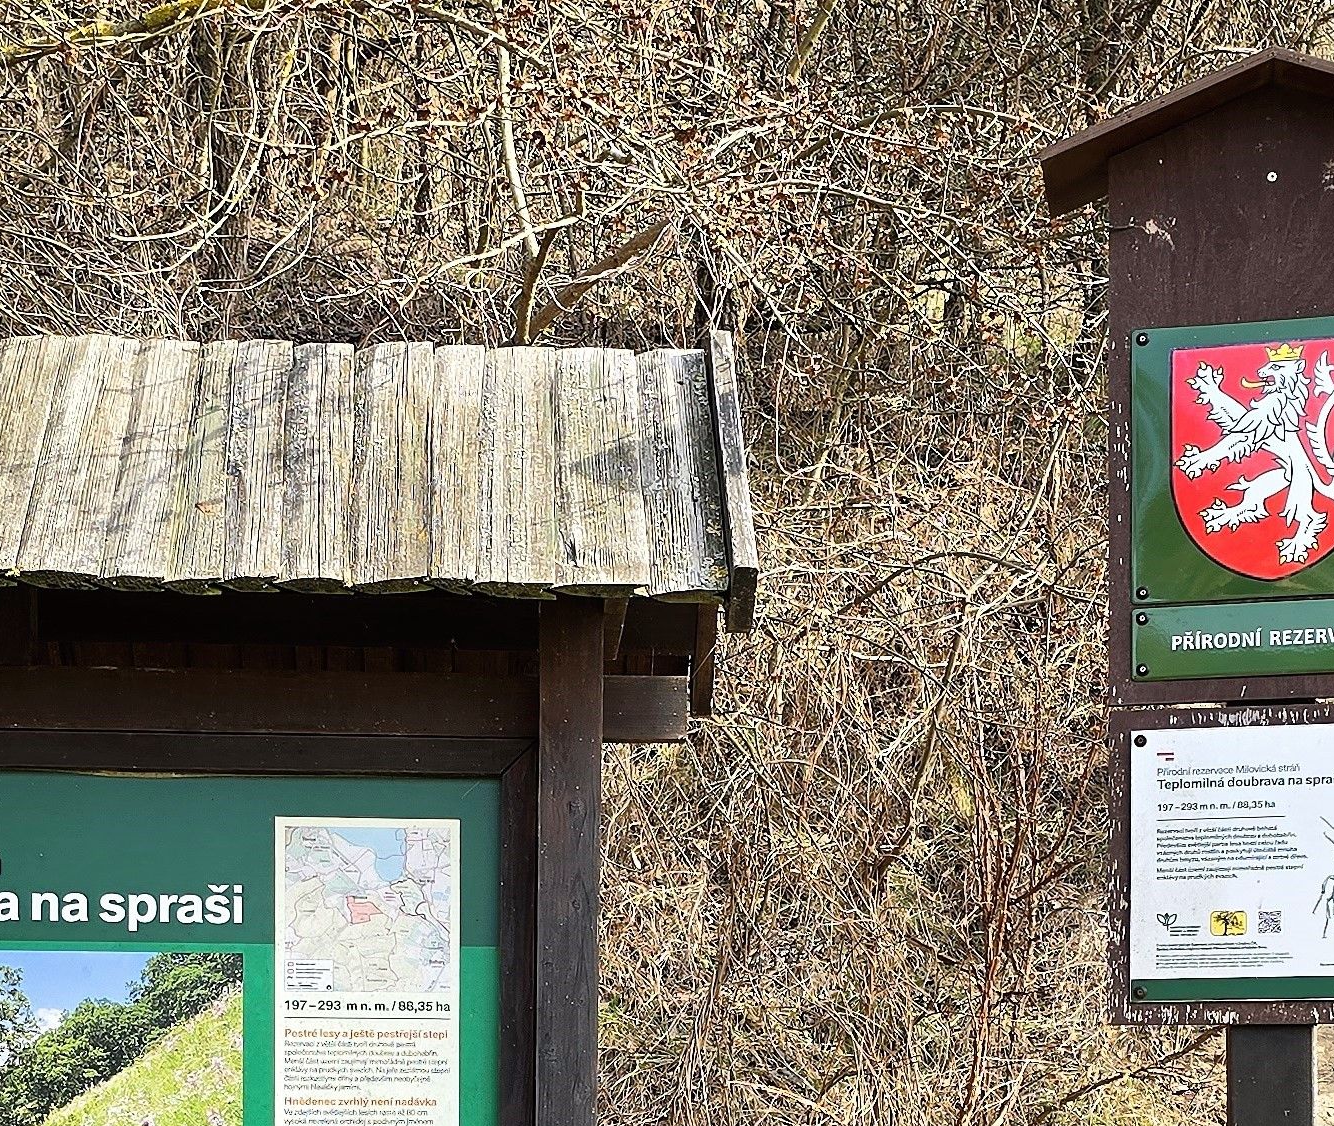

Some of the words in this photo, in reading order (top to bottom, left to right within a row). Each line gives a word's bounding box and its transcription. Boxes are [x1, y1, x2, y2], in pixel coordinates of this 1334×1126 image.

[1171, 627, 1262, 651] PŘÍRODNÍ
[1157, 767, 1191, 777] Přírodní
[1192, 767, 1233, 775] rezervace
[1236, 765, 1276, 774] Milovická
[1279, 763, 1300, 773] stráň
[1157, 776, 1224, 791] Teplomilná
[1227, 775, 1284, 787] doubrava
[1288, 778, 1302, 786] na
[1265, 800, 1276, 808] ha
[31, 890, 89, 924] na
[98, 882, 245, 932] spraši
[346, 1003, 358, 1011] m
[361, 1003, 371, 1011] n.
[436, 1001, 450, 1012] ha
[284, 1097, 336, 1106] Hnědenec
[338, 1097, 369, 1107] zvrhlý
[371, 1097, 393, 1106] není
[395, 1098, 437, 1106] nadávka
